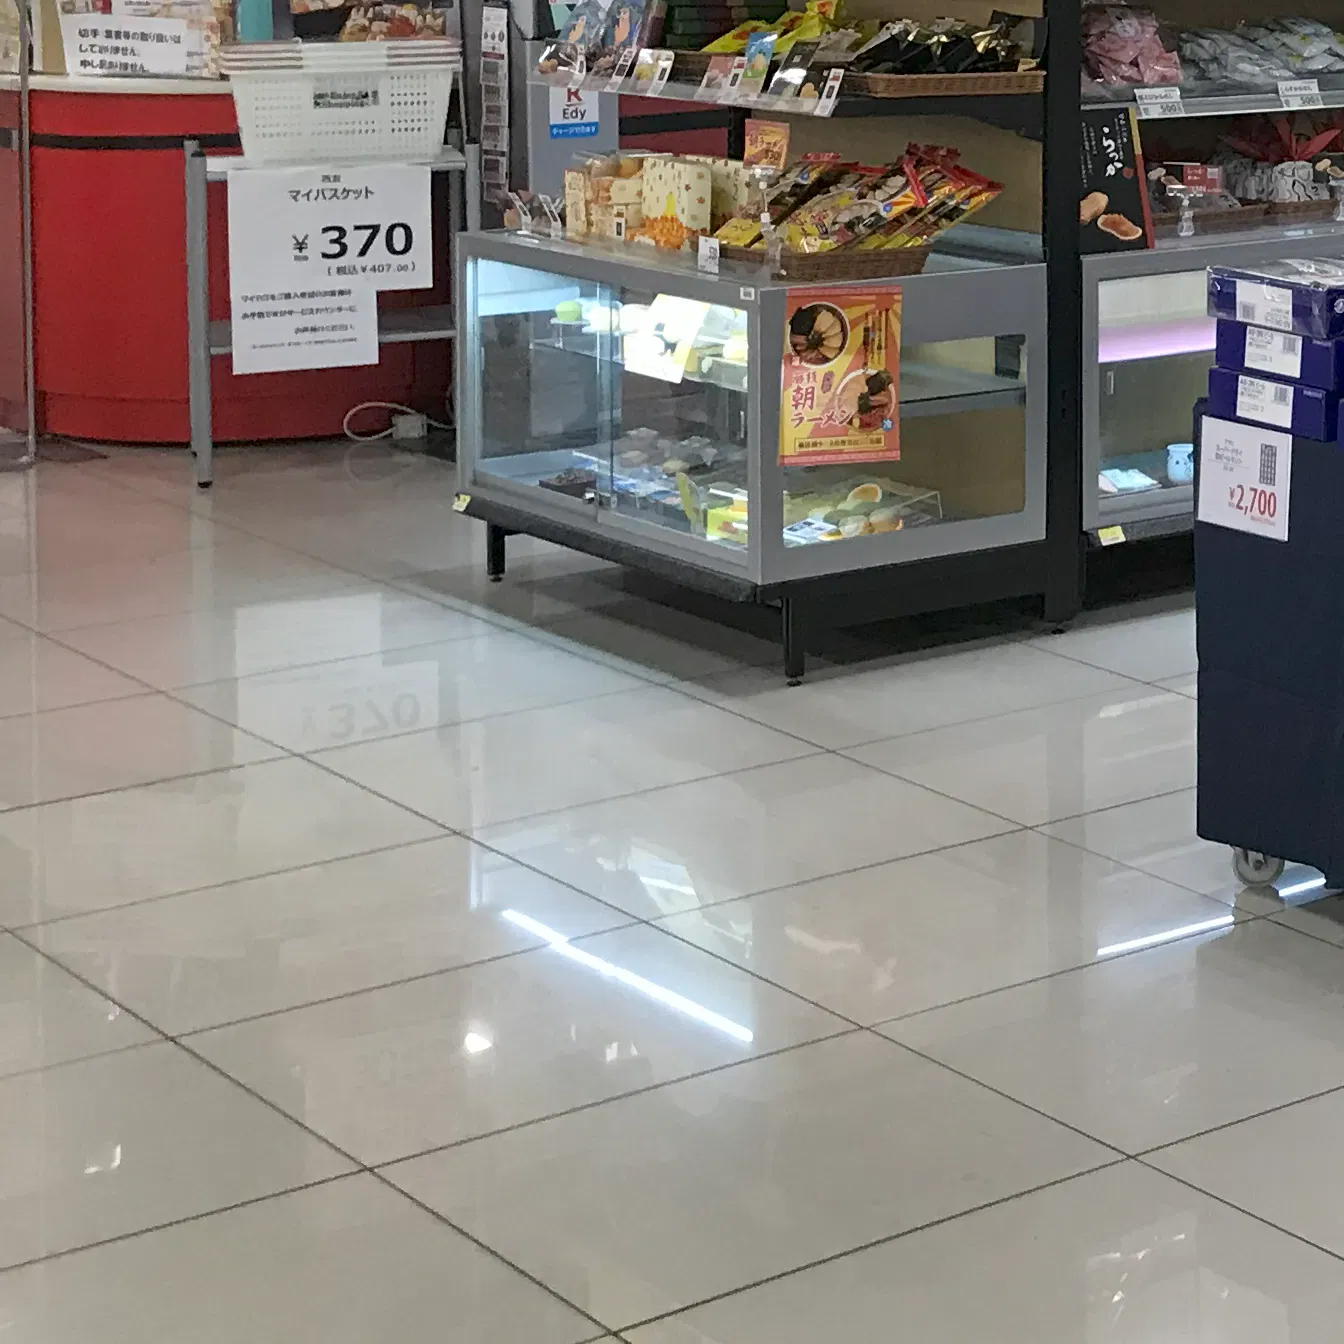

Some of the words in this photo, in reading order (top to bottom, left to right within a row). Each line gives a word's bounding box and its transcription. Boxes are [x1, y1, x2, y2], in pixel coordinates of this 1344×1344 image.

[562, 107, 587, 121] Edy
[288, 186, 374, 202] マイバスケット
[320, 222, 413, 260] 370
[792, 385, 816, 411] 朝
[791, 411, 851, 428] ラーメン
[1229, 484, 1277, 517] ¥2,700
